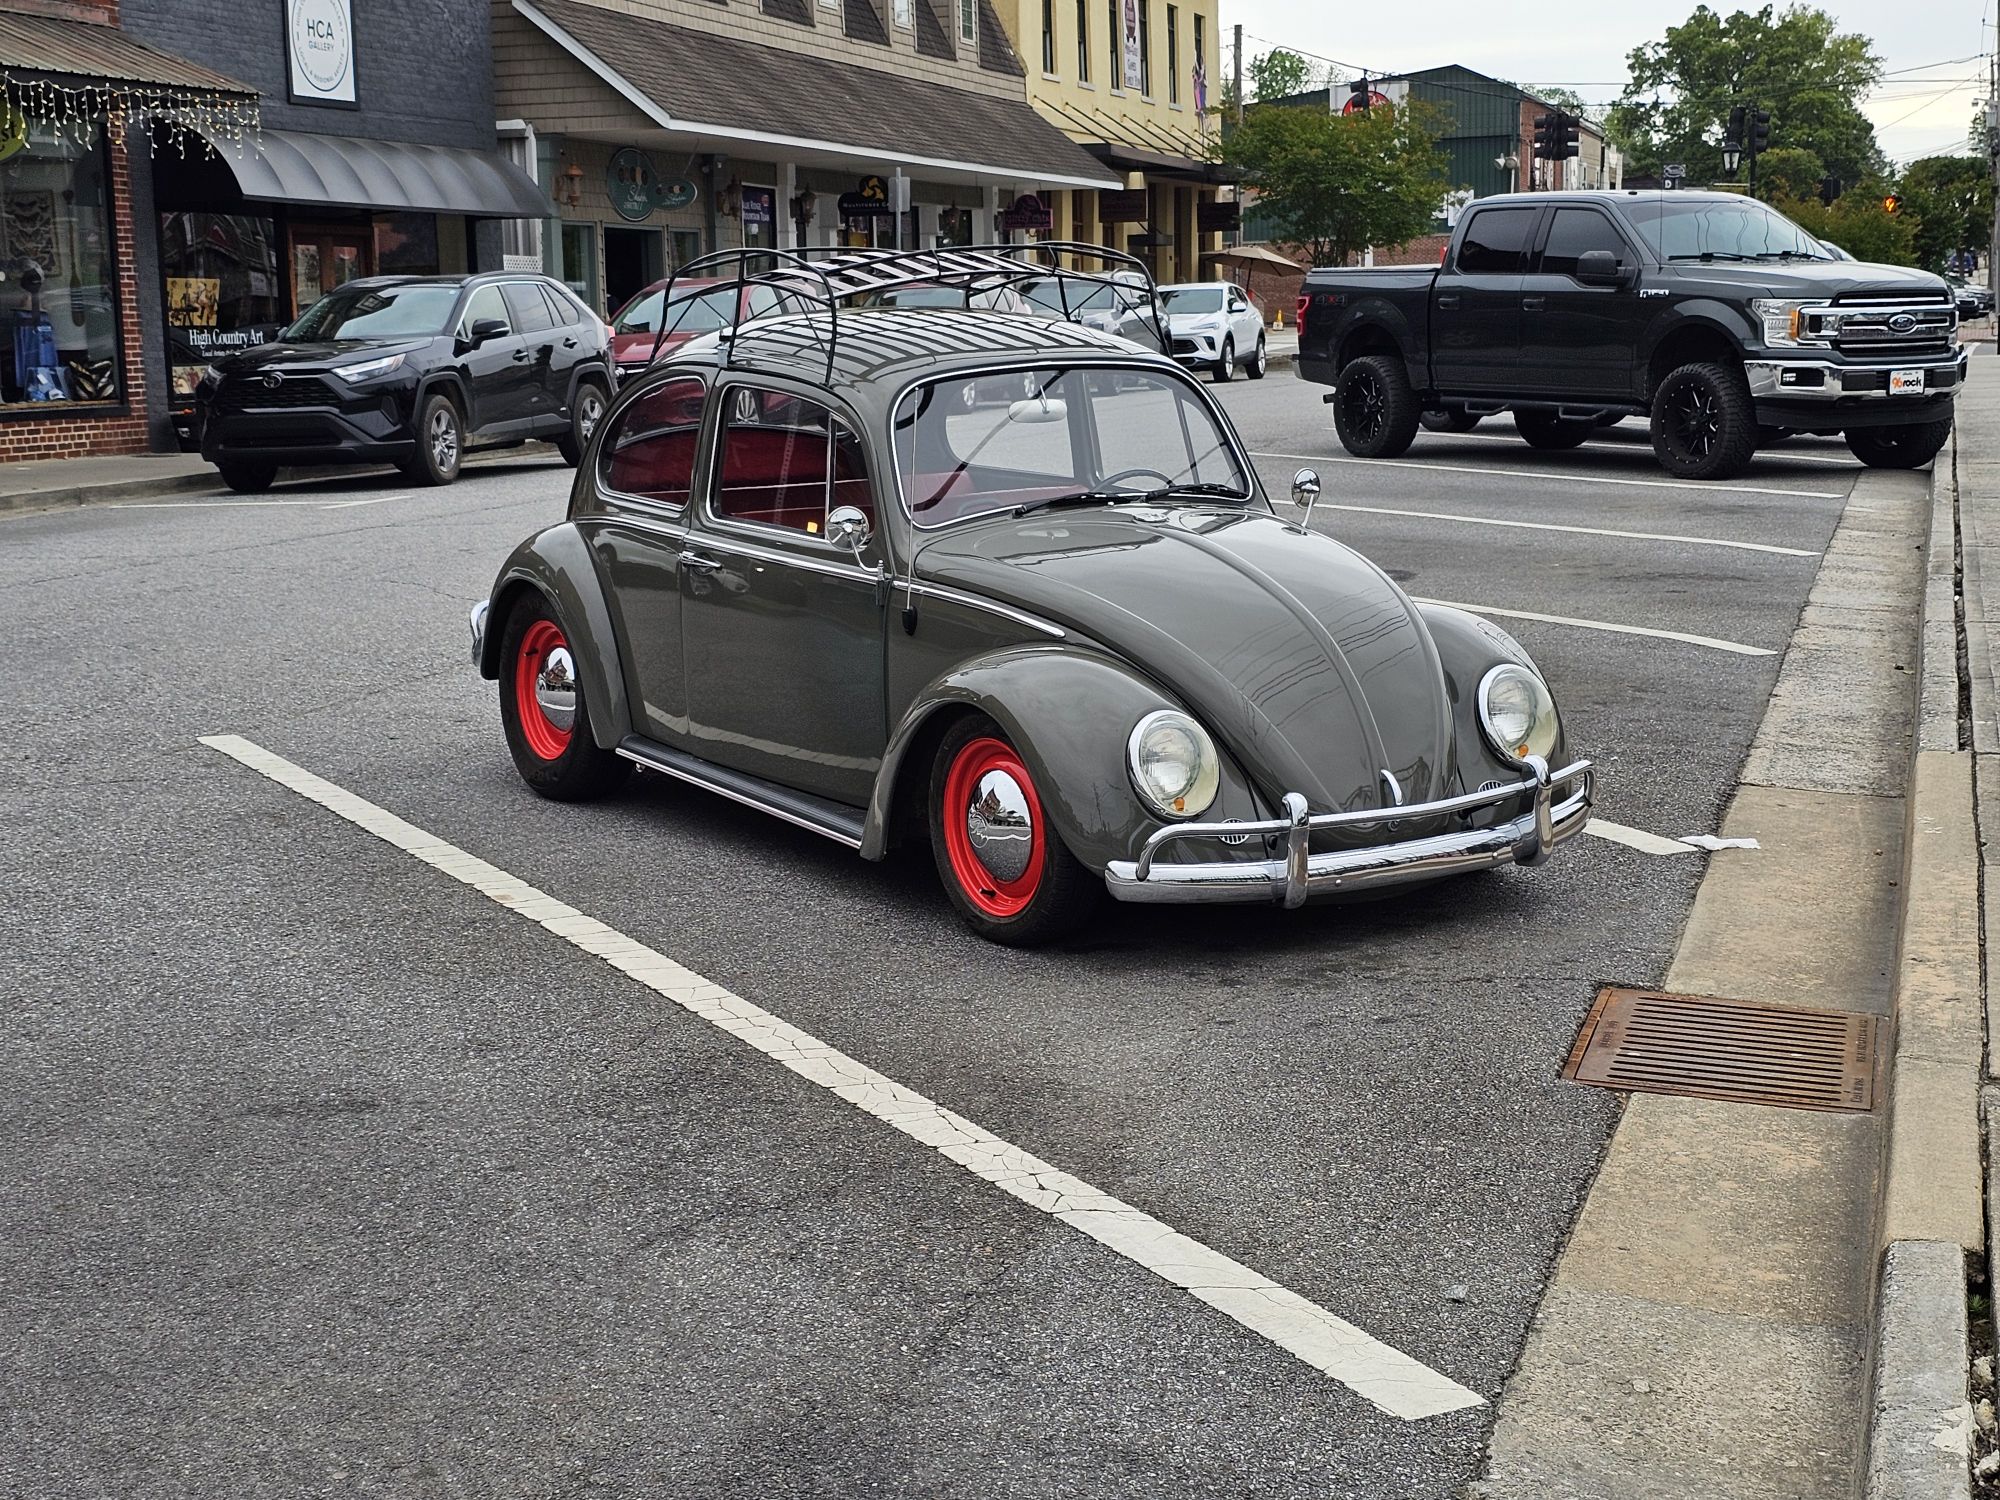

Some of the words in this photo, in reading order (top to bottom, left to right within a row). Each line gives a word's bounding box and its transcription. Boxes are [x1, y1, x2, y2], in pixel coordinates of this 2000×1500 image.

[306, 18, 335, 40] HCA
[308, 40, 335, 52] GALLERY
[189, 328, 212, 349] High
[212, 328, 248, 348] Country
[249, 328, 265, 344] Art
